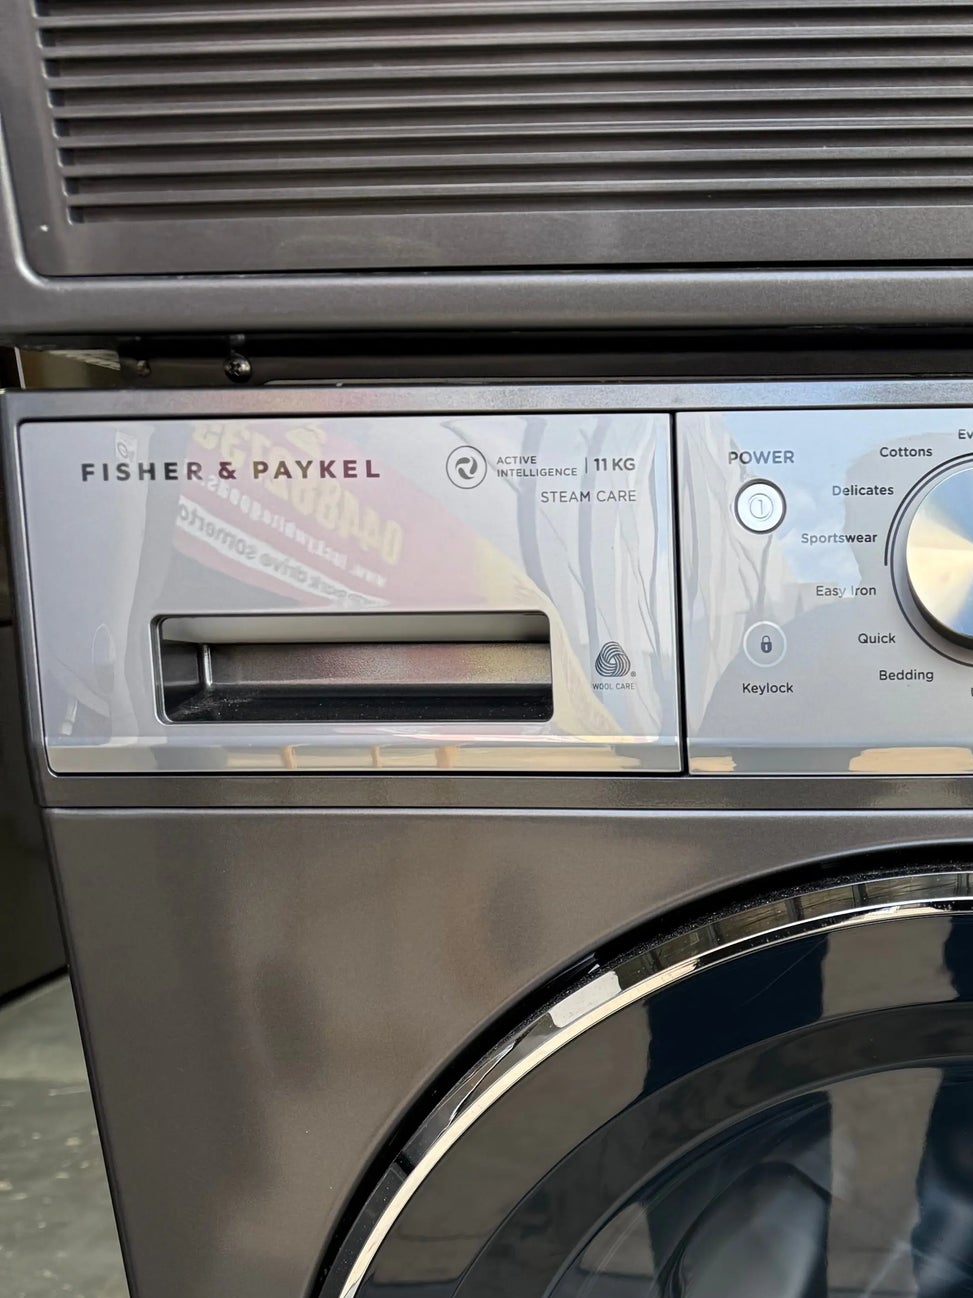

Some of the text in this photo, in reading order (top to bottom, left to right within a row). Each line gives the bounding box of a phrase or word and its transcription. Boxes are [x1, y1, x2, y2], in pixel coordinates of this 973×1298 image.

[728, 450, 795, 465] POWER
[879, 445, 933, 458] Cottons
[496, 456, 537, 465] ACTIVE
[594, 457, 636, 472] 11 KG
[81, 460, 381, 482] FISHER & PAYKEL
[497, 468, 578, 478] INTELLIGENCE
[541, 490, 637, 504] STEAM CARE
[832, 484, 895, 496] Delicates
[801, 532, 878, 546] Sportswear
[815, 585, 877, 599] Easy Iron
[858, 632, 896, 645] Quick
[878, 669, 934, 683] Bedding
[742, 681, 794, 696] Keylock
